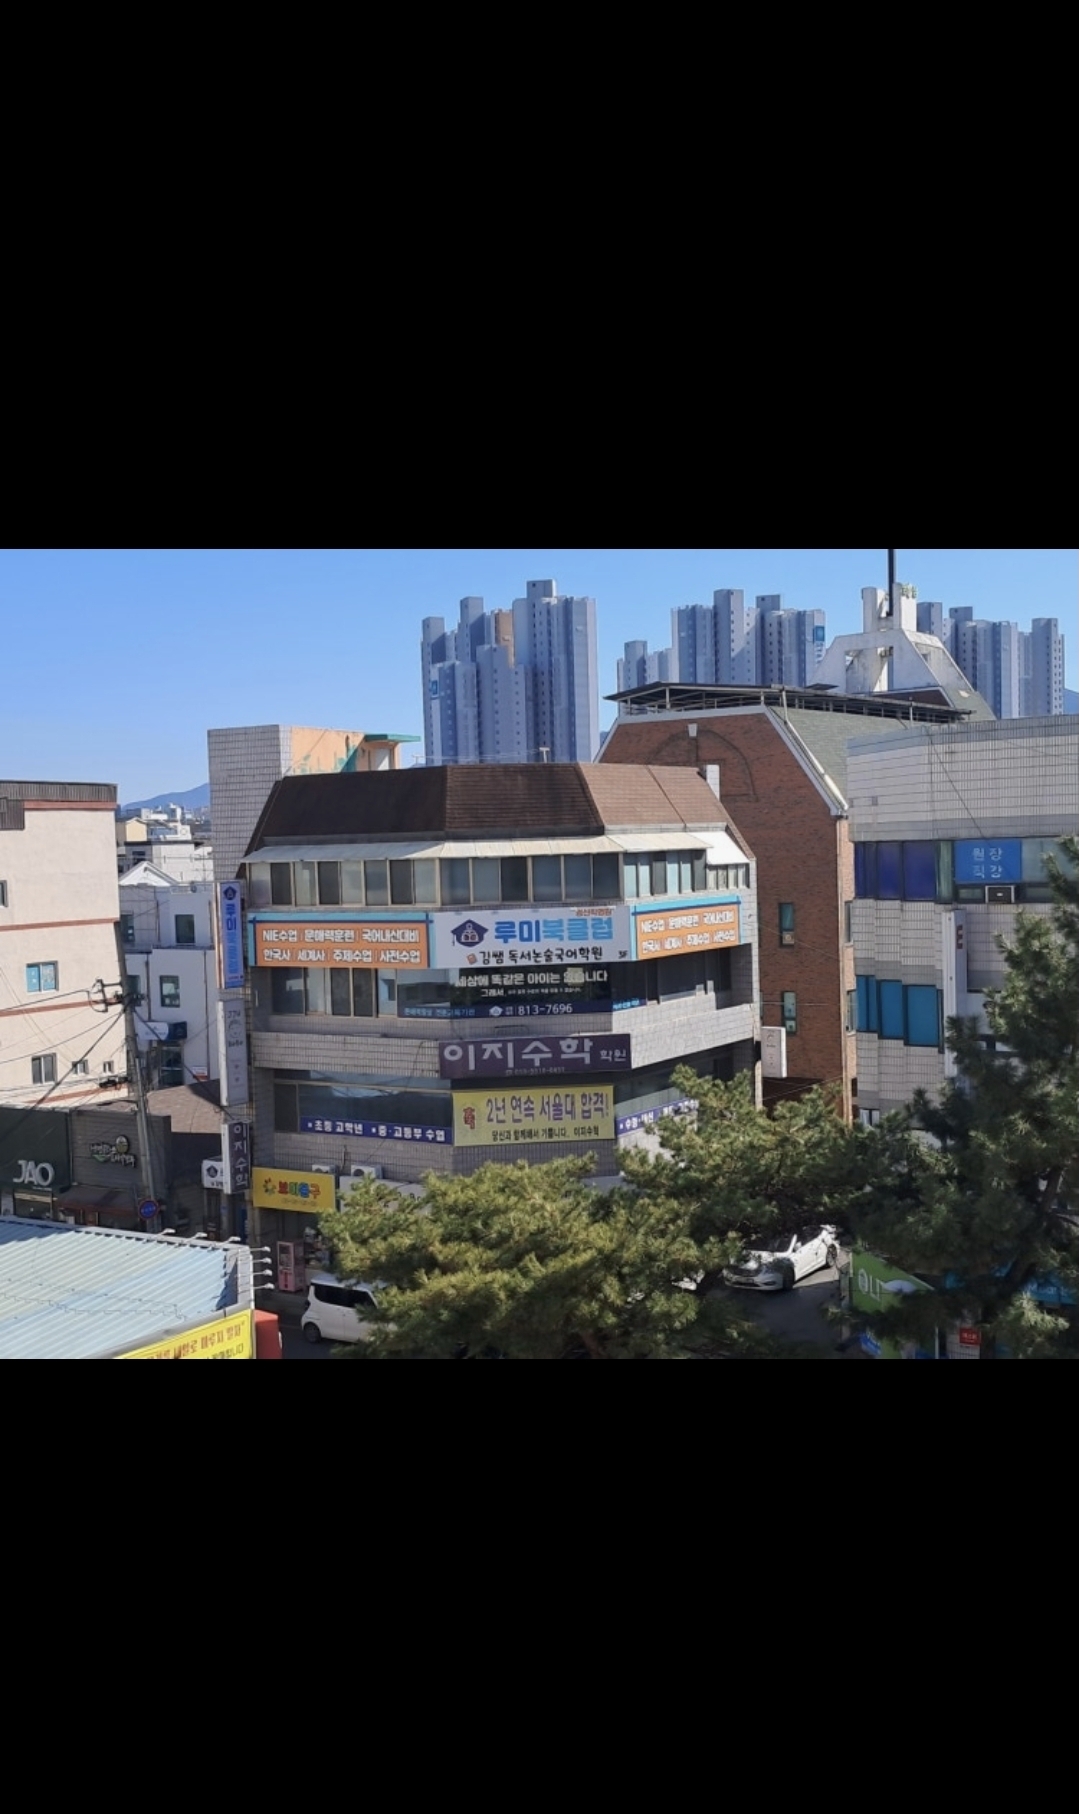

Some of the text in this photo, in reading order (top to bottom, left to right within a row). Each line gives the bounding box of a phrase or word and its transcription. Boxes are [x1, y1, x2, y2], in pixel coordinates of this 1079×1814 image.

[972, 847, 1003, 862] 원장
[972, 864, 1003, 879] 직강
[262, 928, 420, 943] NIE수업 문해력훈련 국어내신대비
[494, 917, 614, 944] 루미북클럽
[263, 948, 291, 962] 한국사
[297, 948, 325, 962] 세계사
[333, 948, 372, 963] 주제수업
[479, 946, 603, 966] 김쌤 독서논술국어학원
[455, 975, 489, 987] 세상에
[491, 974, 525, 986] 똑같은
[527, 972, 560, 984] 아이는
[517, 1004, 573, 1016] 813-7696
[443, 1038, 593, 1071] 이지수학
[599, 1049, 627, 1062] 학원
[462, 1106, 476, 1130] 축
[486, 1092, 609, 1124] 2년 연속 서울대 합격!
[314, 1119, 333, 1132] 초등
[335, 1121, 363, 1135] 고학년
[425, 1129, 446, 1142] 수업
[233, 1122, 249, 1187] 이지수학
[12, 1159, 55, 1186] JAO
